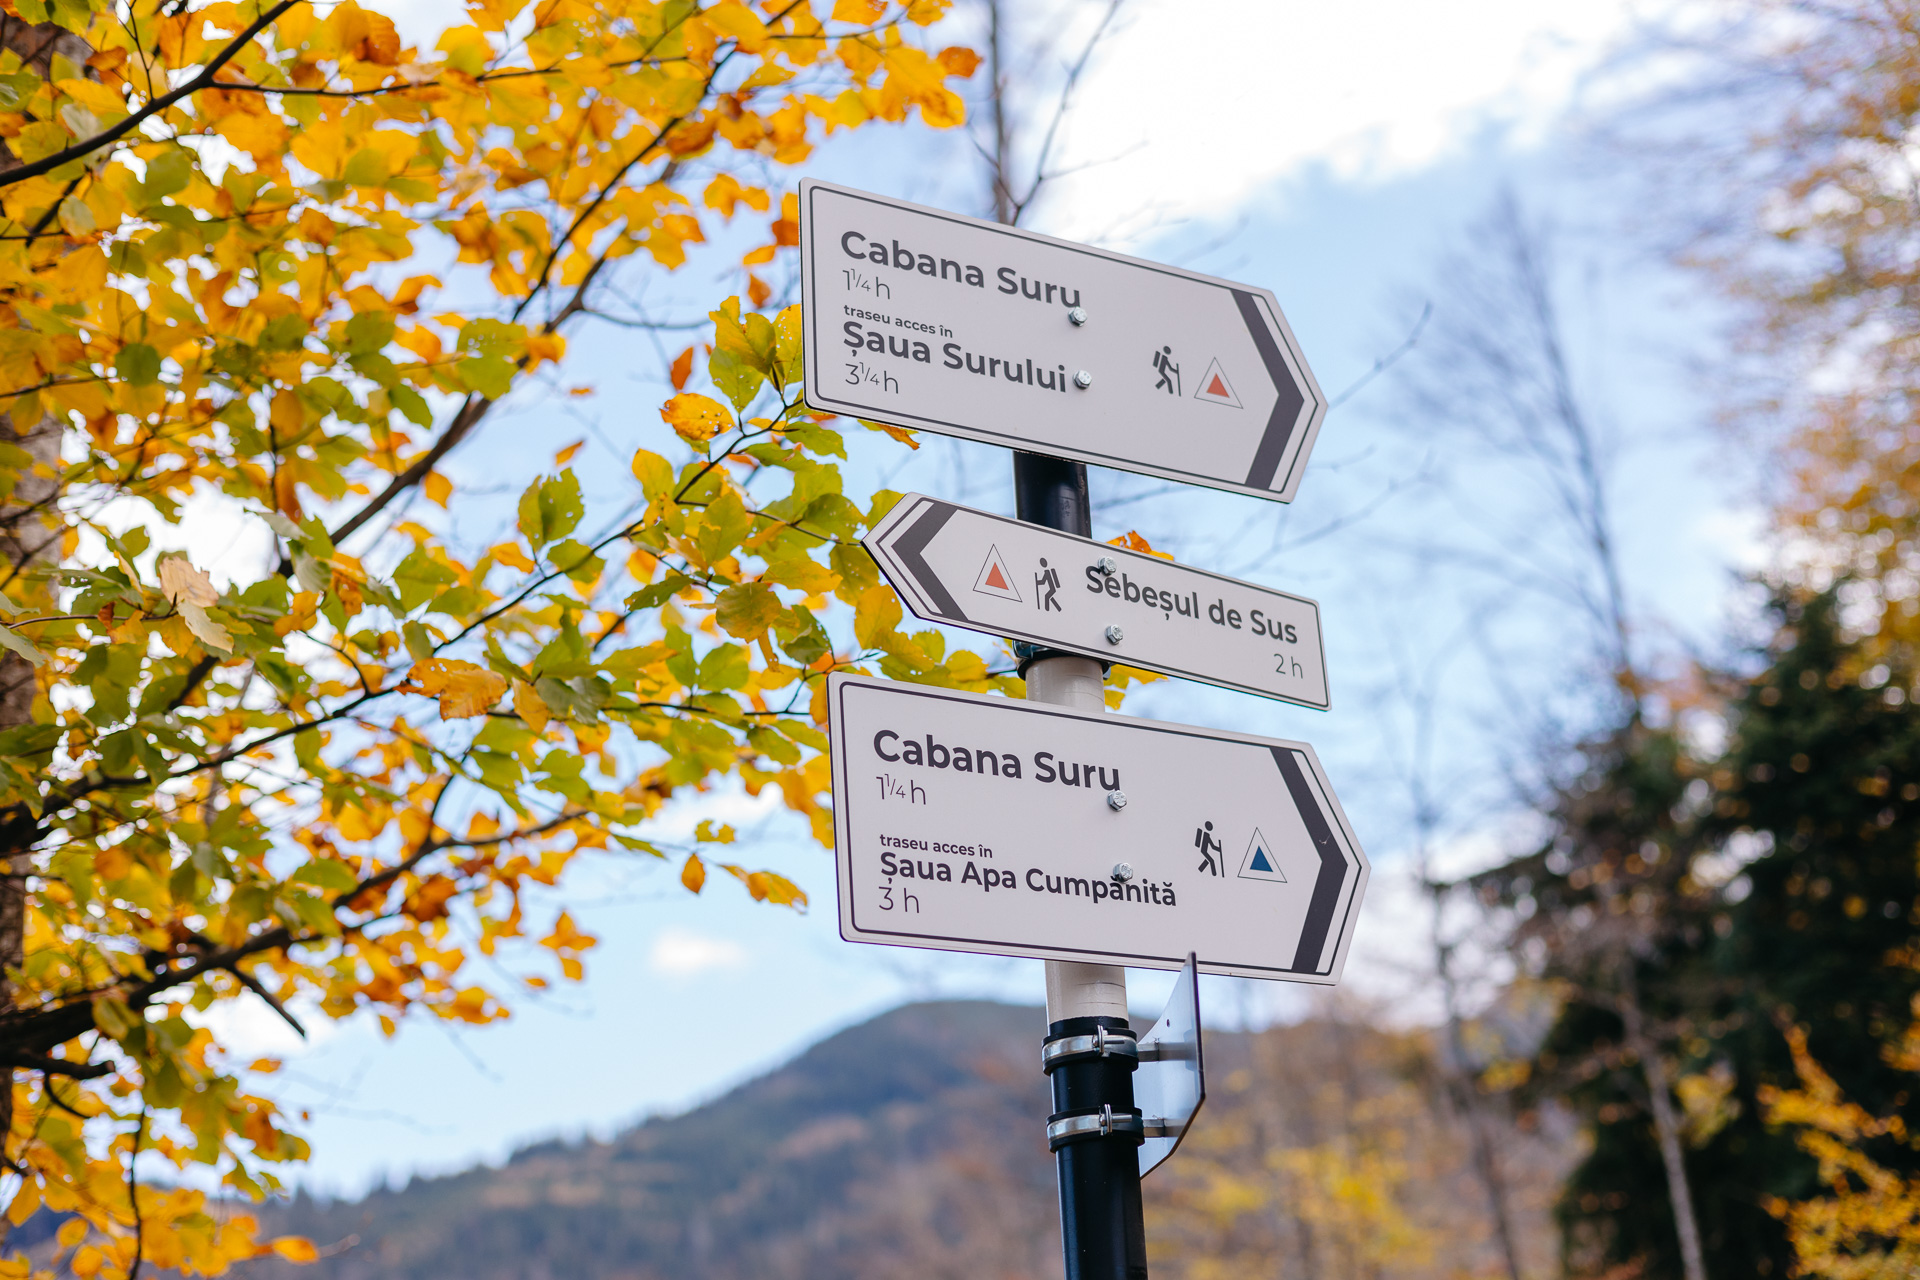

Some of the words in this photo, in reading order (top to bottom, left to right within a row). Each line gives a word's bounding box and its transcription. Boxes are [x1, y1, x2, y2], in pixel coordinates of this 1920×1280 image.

[841, 231, 984, 288] Cabana
[996, 267, 1081, 308] Suru
[843, 304, 891, 324] traseu
[895, 317, 936, 335] acces
[938, 324, 954, 338] în
[843, 320, 931, 364] Șaua
[943, 343, 1067, 393] Surului
[1085, 565, 1199, 621] Sebeșul
[1208, 598, 1242, 630] de
[1251, 611, 1298, 644] Sus
[873, 729, 1022, 779] Cabana
[1034, 752, 1121, 791] Suru
[879, 834, 928, 851] traseu
[932, 842, 975, 856] acces
[977, 843, 993, 859] în
[880, 851, 952, 884] Șaua
[960, 861, 1017, 893] Apa
